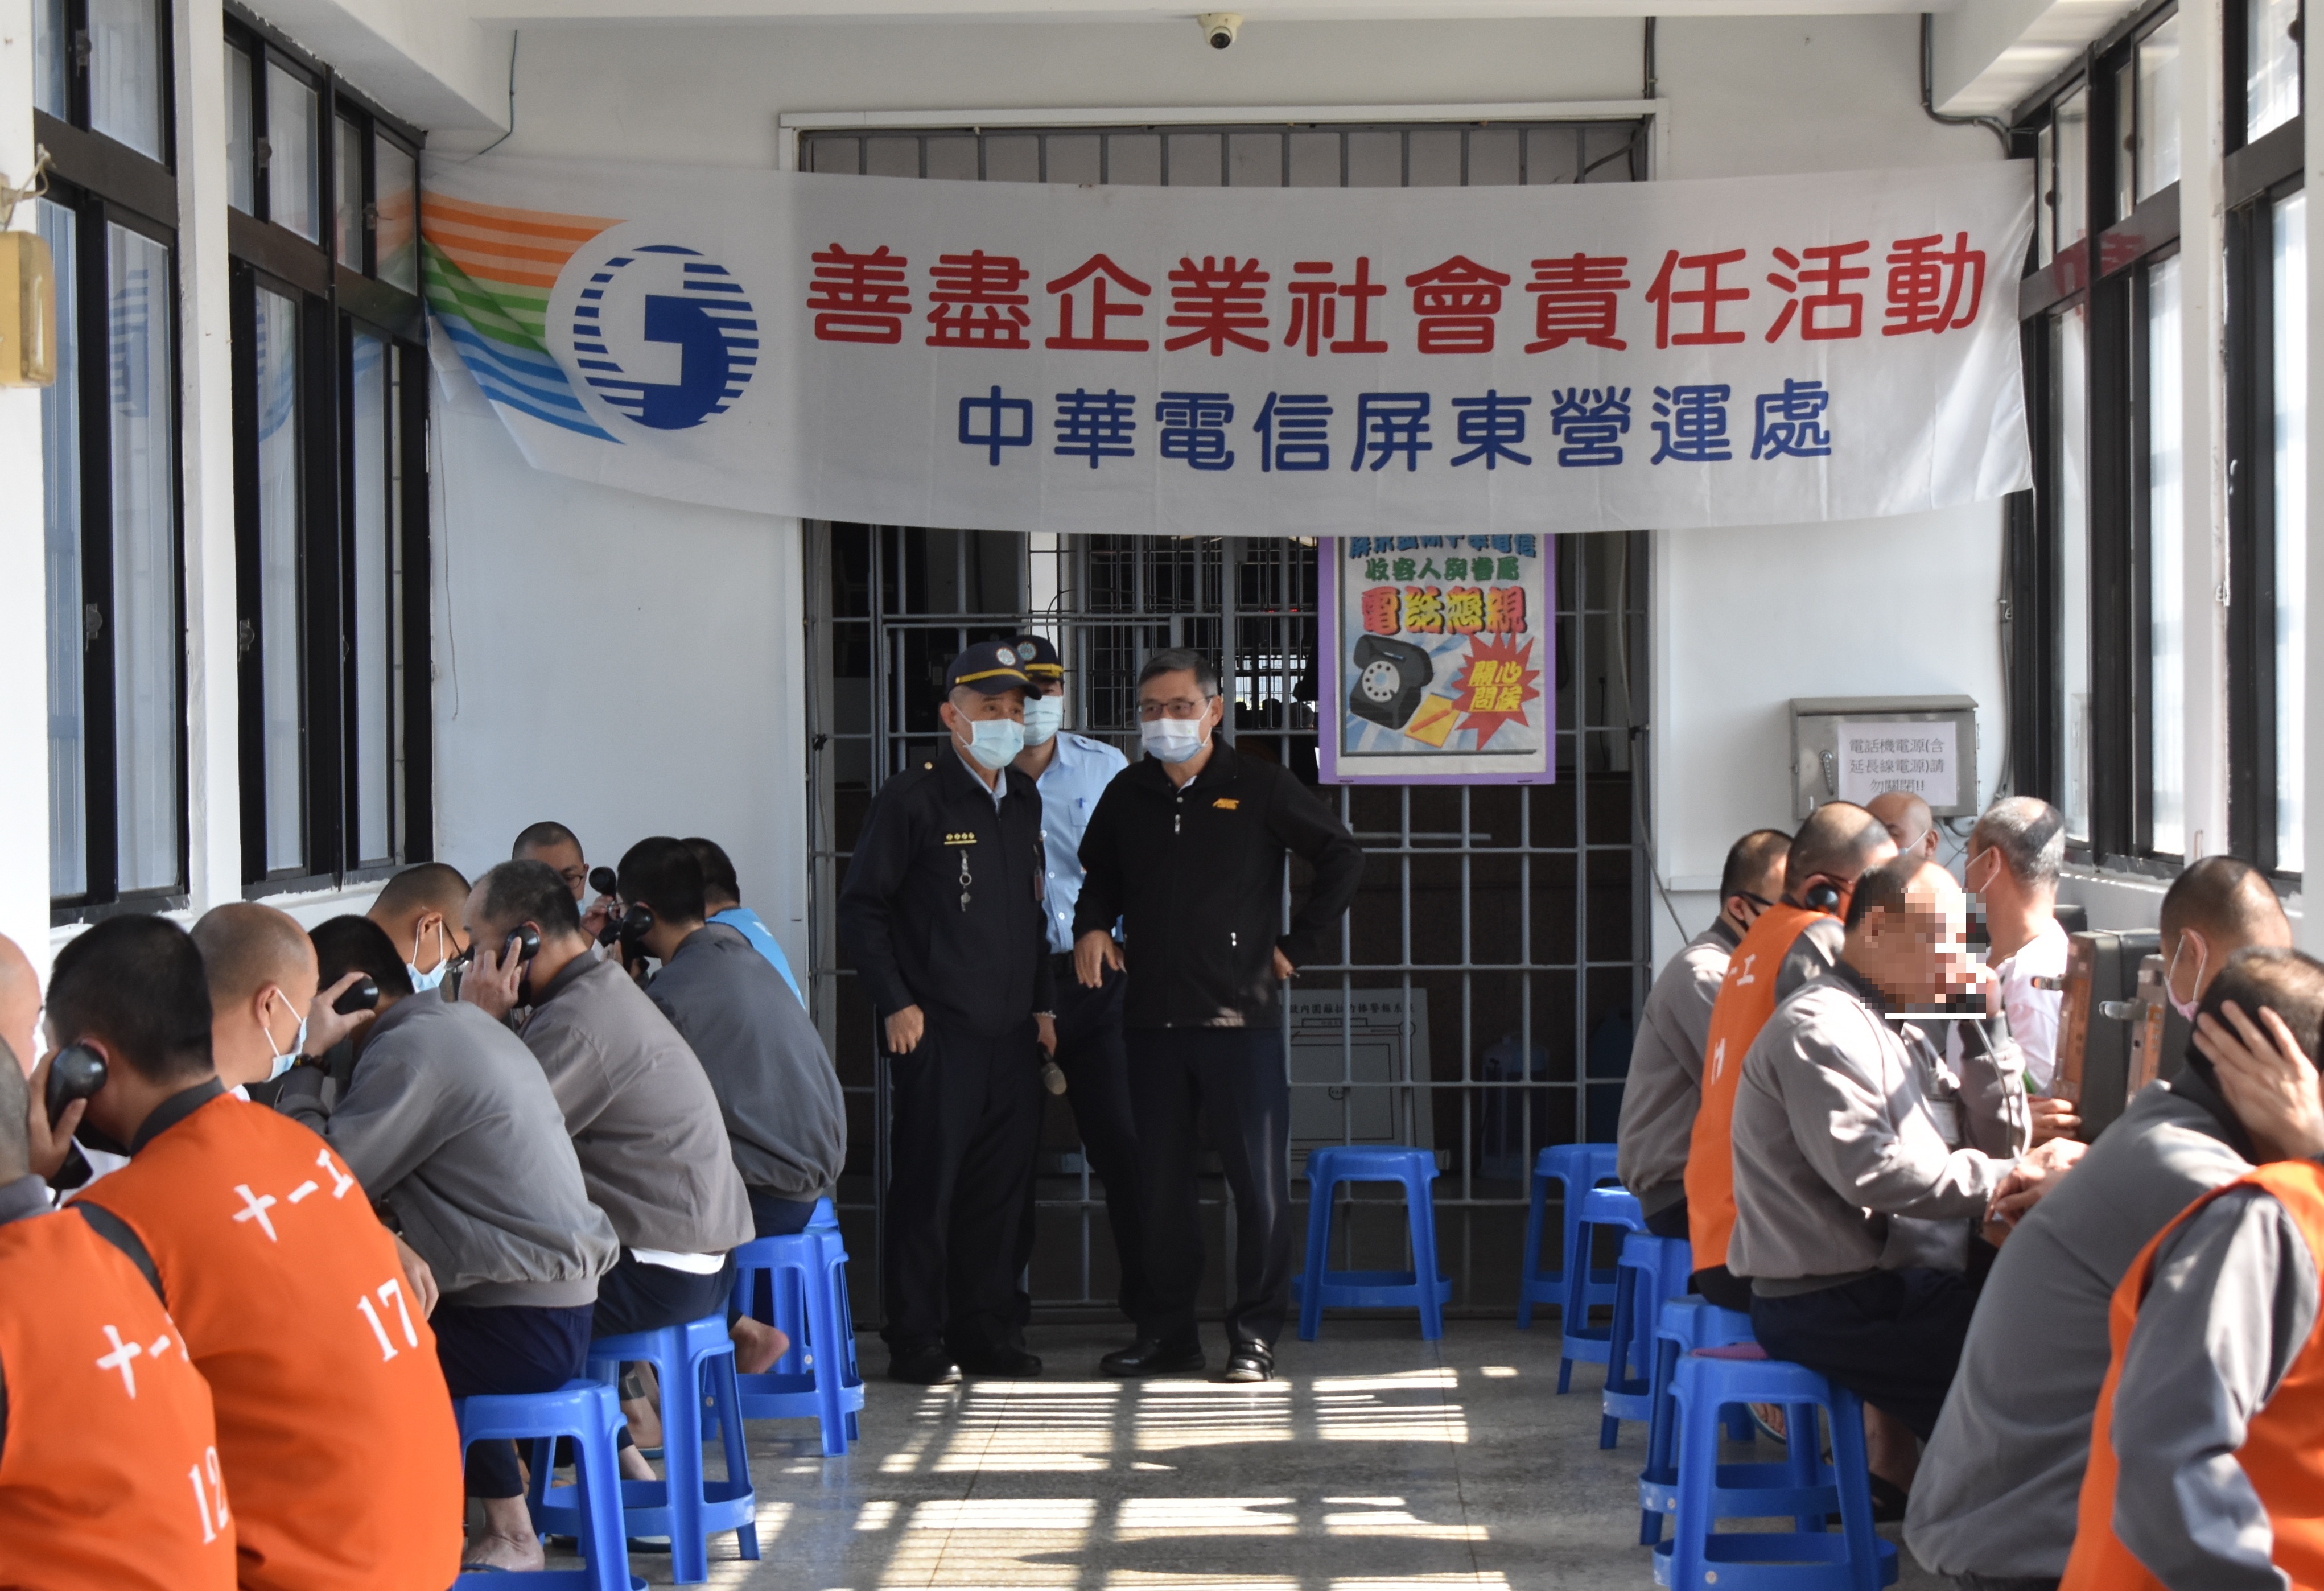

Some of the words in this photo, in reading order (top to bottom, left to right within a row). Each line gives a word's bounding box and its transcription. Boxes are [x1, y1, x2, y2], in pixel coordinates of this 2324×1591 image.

[807, 231, 1986, 356] 善盡企業社會責任活動
[959, 378, 1832, 471] 中華電信屏東營運處
[1470, 686, 1523, 711] 問候
[1849, 738, 1944, 753] 電話機電源(含
[1850, 759, 1944, 774] 延長線電源)請
[1870, 778, 1925, 793] 勿關閉!!
[232, 1148, 354, 1243] 十一工
[96, 1312, 189, 1400] 十一
[357, 1277, 418, 1362] 17
